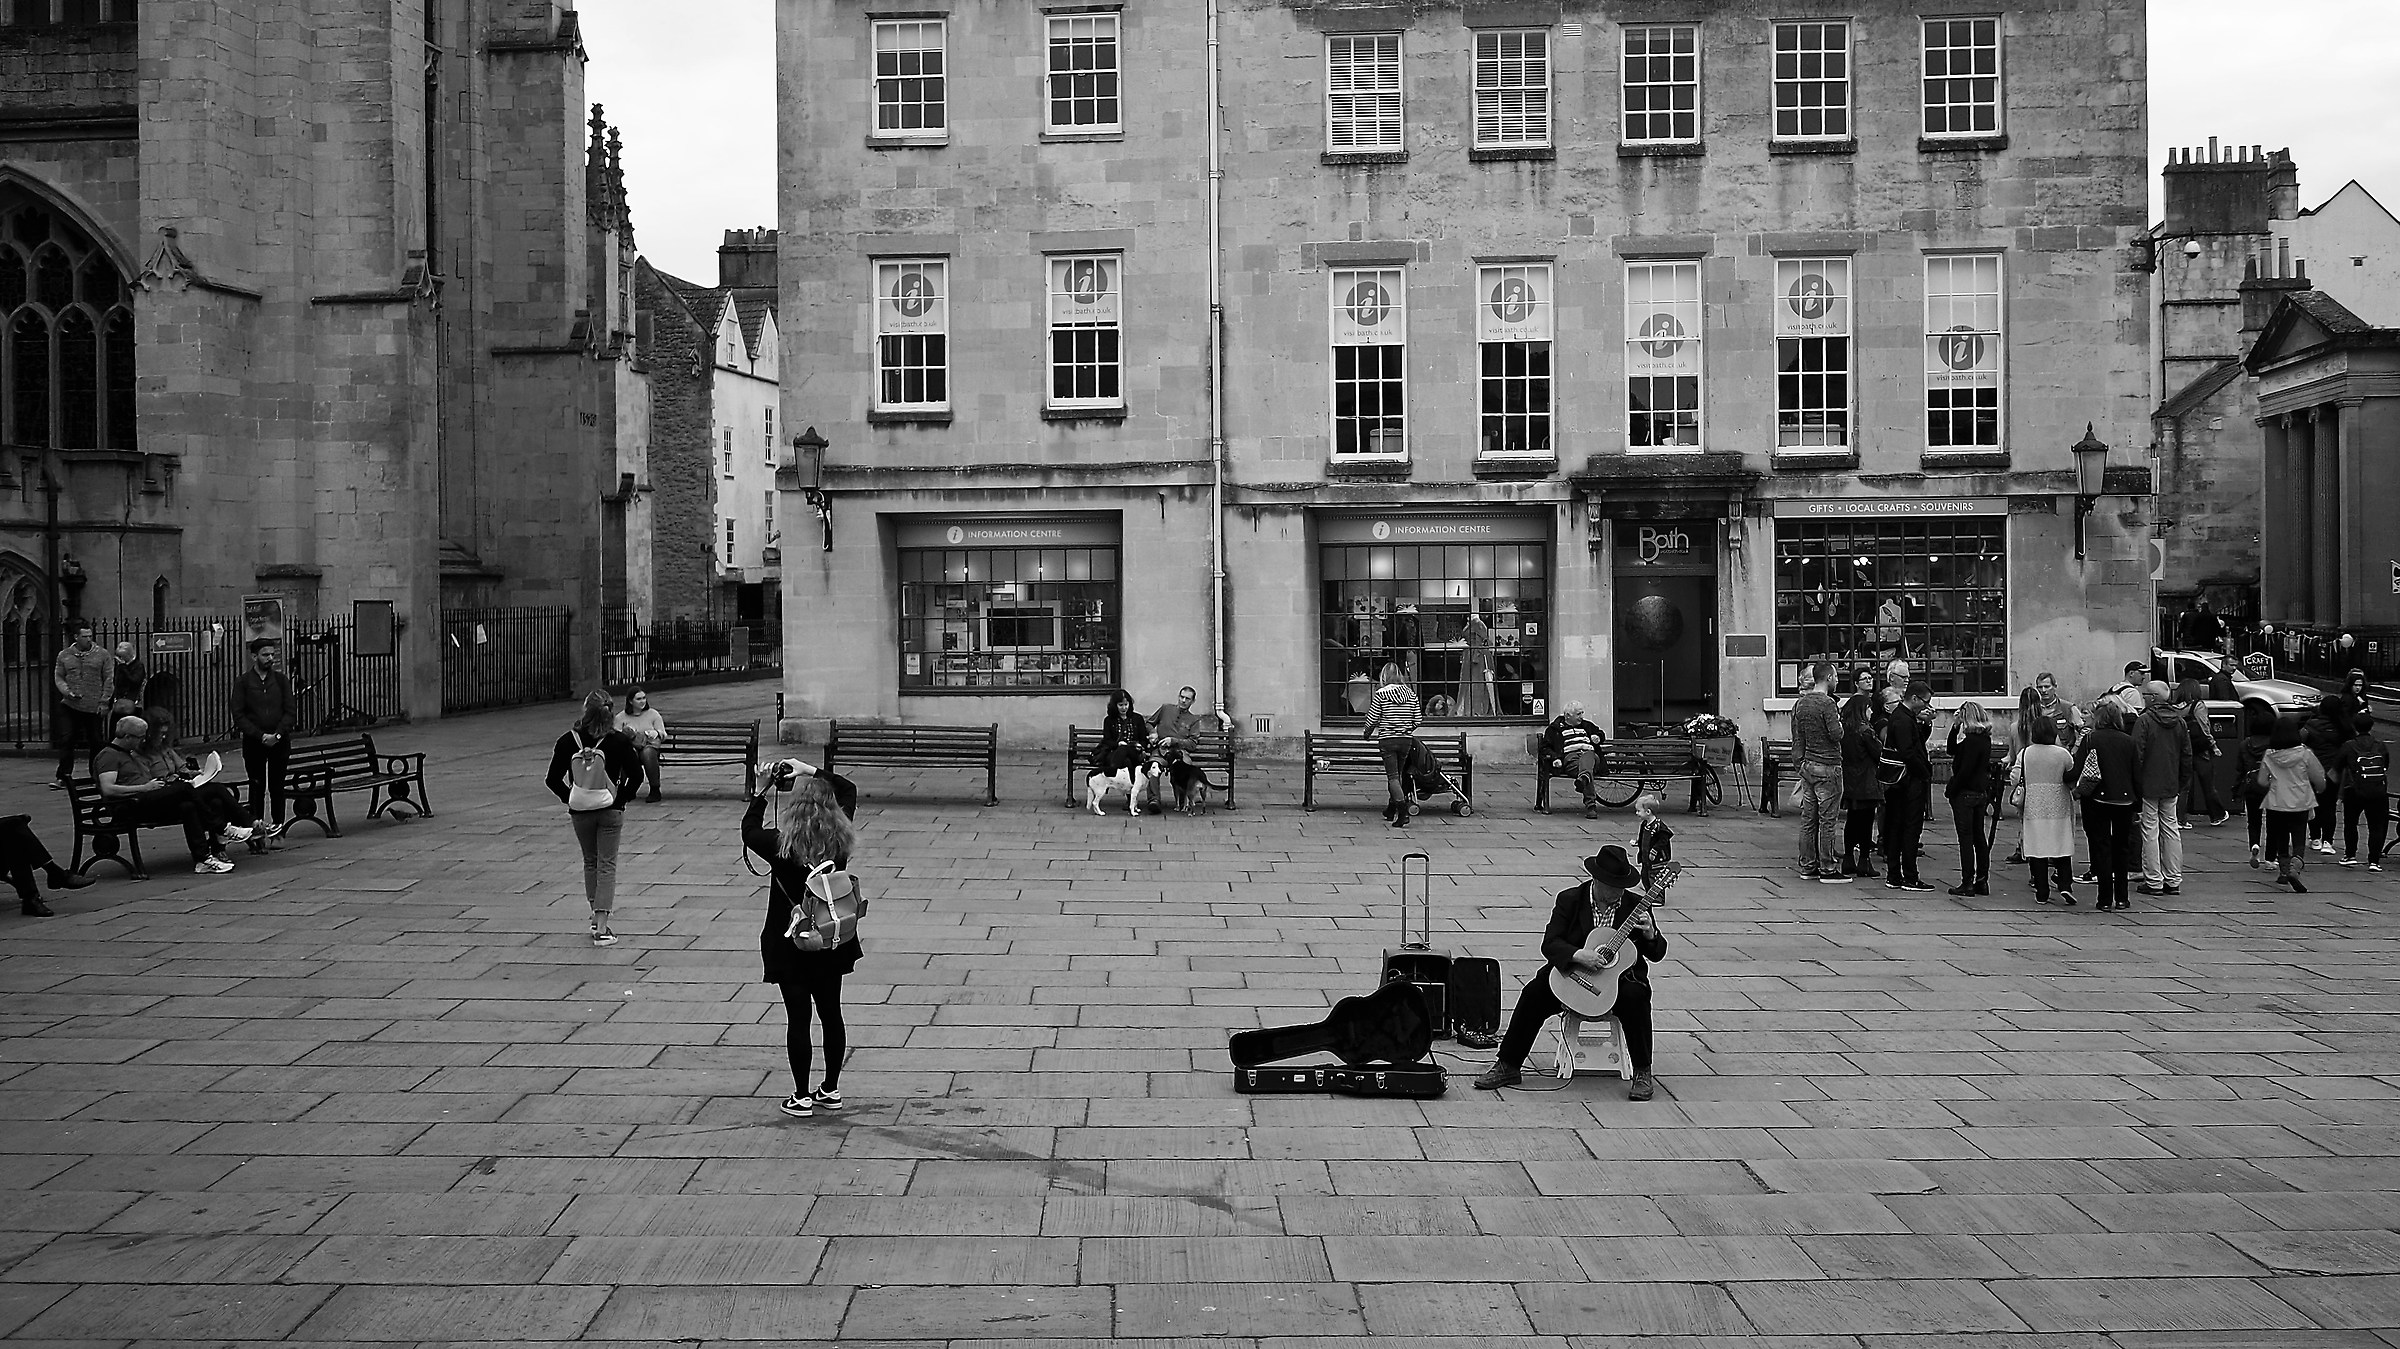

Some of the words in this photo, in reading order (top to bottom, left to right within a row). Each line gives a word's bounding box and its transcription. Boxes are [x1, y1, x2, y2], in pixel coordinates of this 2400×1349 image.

[1808, 503, 1834, 514] GIFTS
[1845, 503, 1875, 513] LOCAL
[1877, 502, 1911, 513] CRAFTS
[1920, 501, 1974, 512] SOUVENIRS
[968, 530, 1028, 539] INFORMATION
[1030, 529, 1062, 539] CENTRE
[1395, 525, 1456, 535] INFORMATION
[1459, 525, 1491, 534] CENTRE
[1639, 526, 1690, 562] Bath
[2246, 656, 2269, 665] CRAFT
